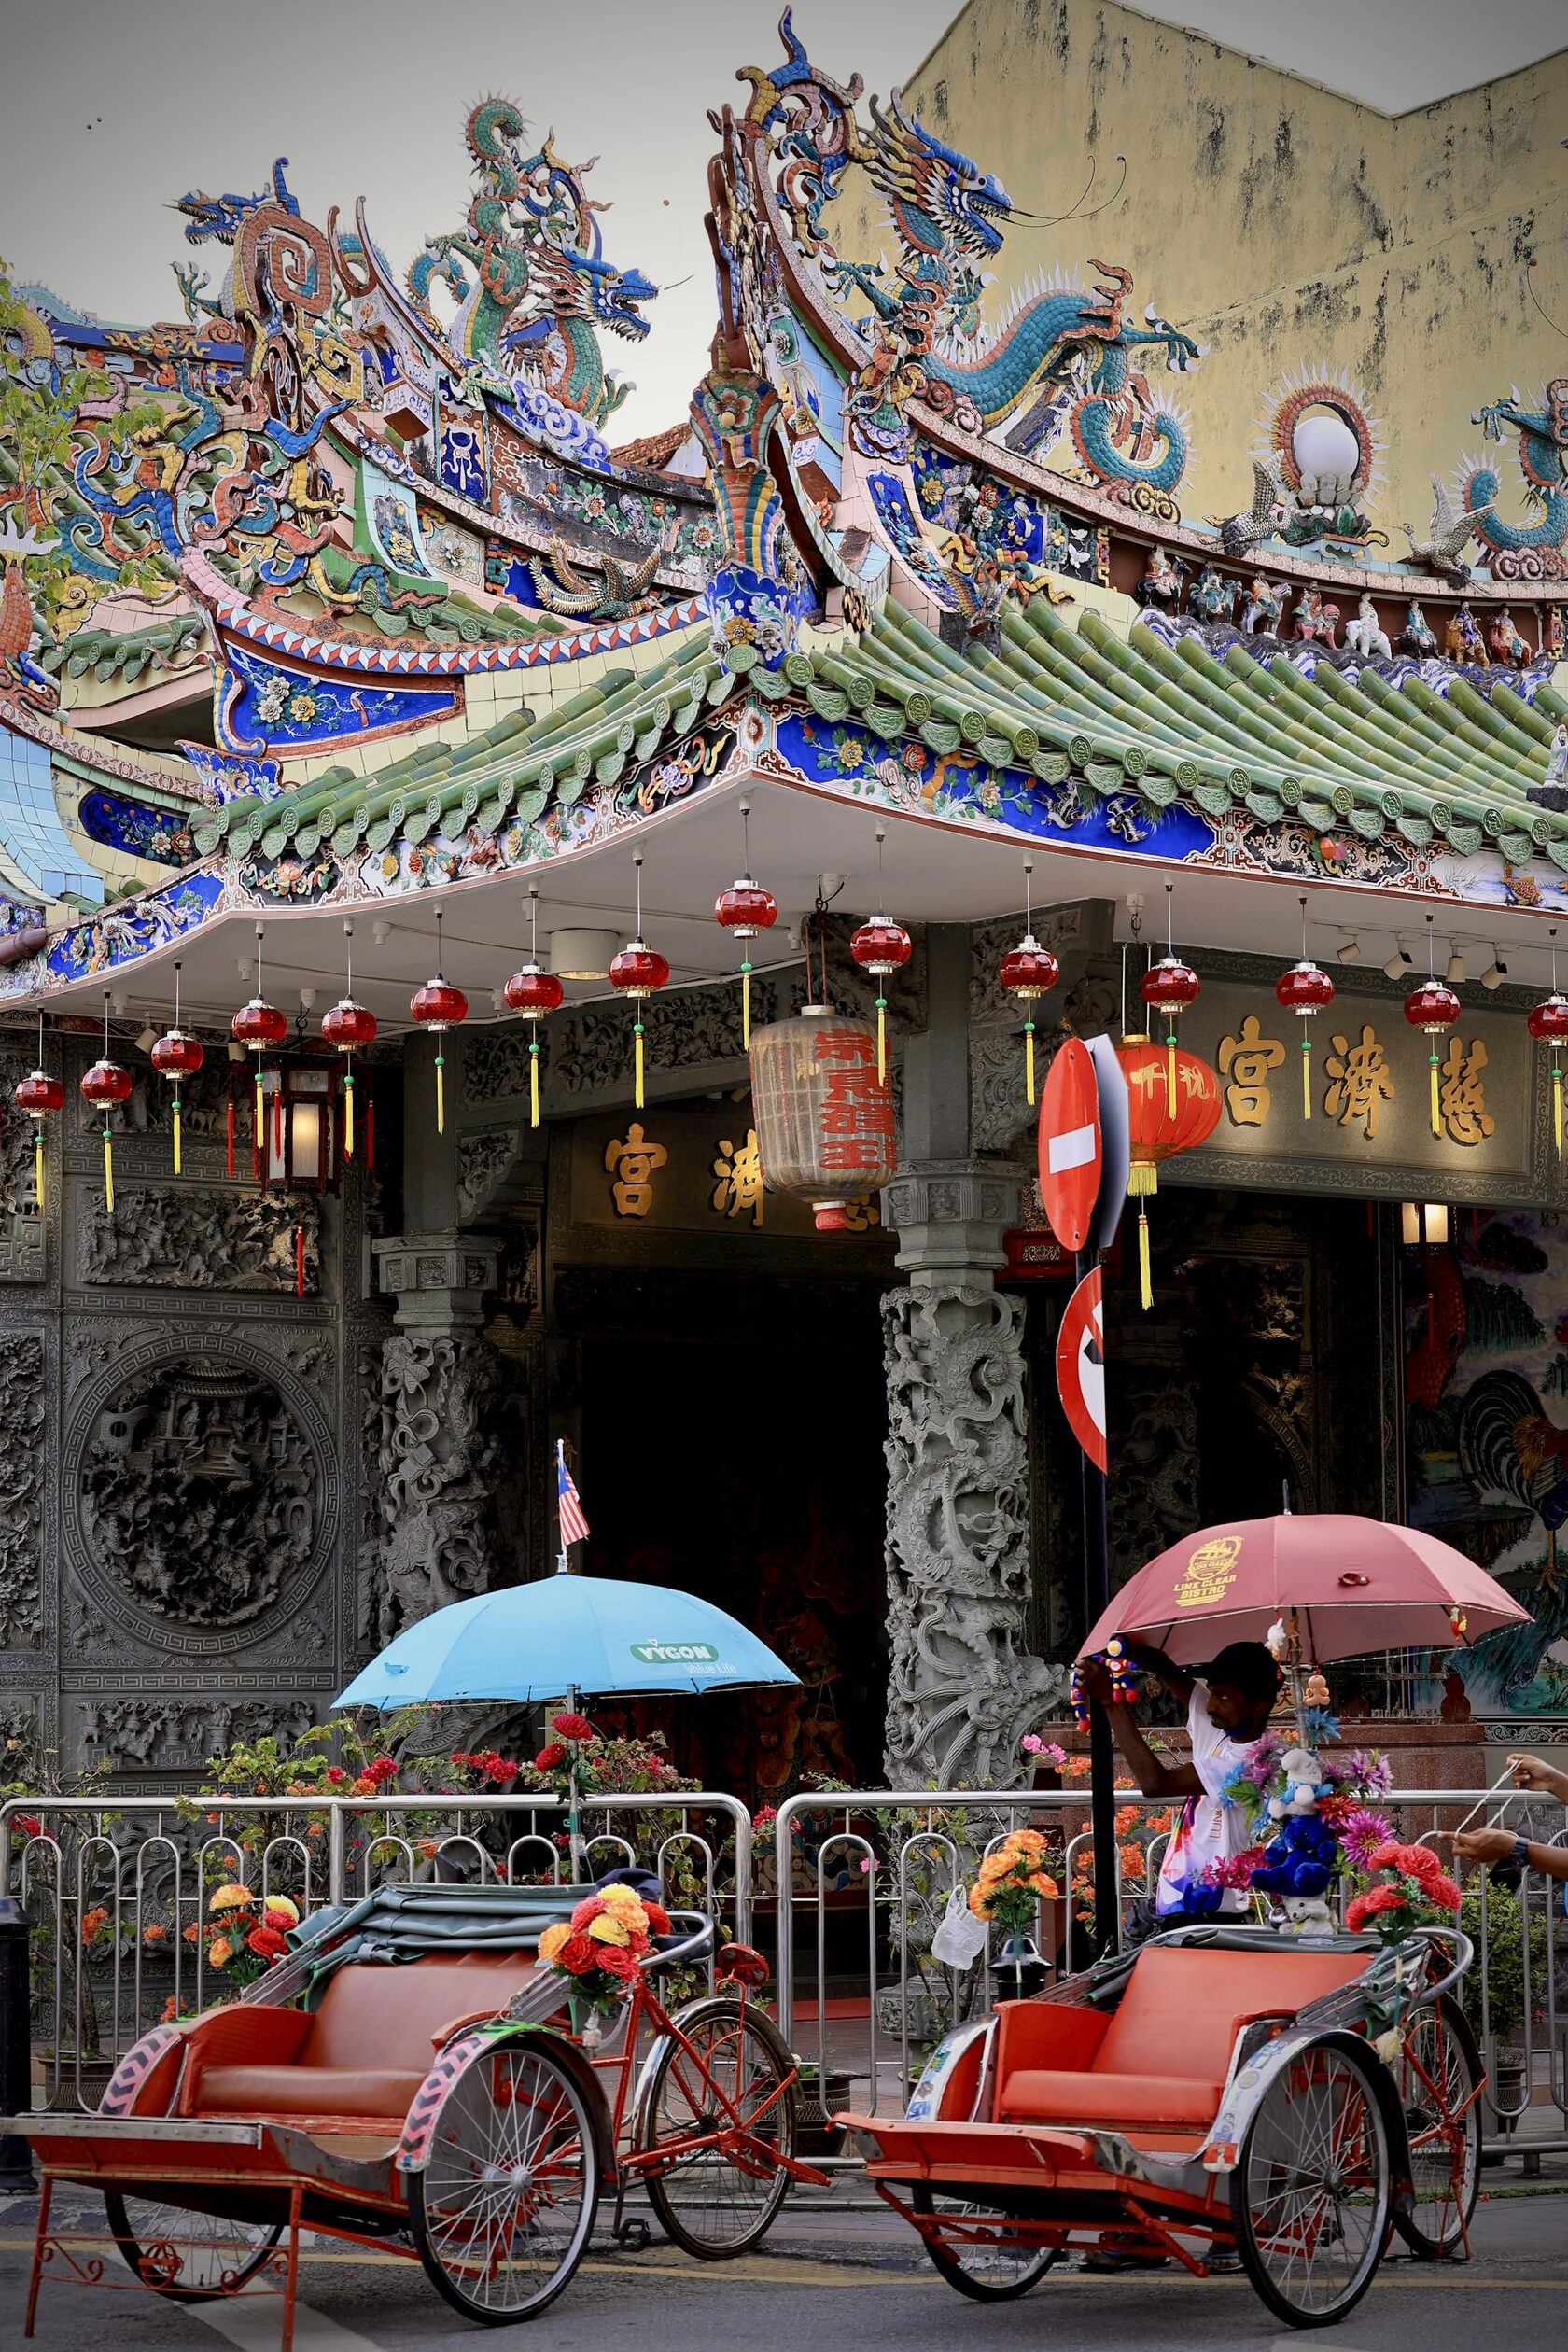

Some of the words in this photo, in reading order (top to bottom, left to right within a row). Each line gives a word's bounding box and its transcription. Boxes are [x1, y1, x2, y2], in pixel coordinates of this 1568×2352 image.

[1173, 1581, 1200, 1592] LINE
[1201, 1575, 1237, 1588] CLEAR
[1179, 1585, 1225, 1599] BISTRO
[637, 1645, 711, 1660] VYGON
[685, 1663, 715, 1674] Value
[717, 1663, 737, 1673] Life
